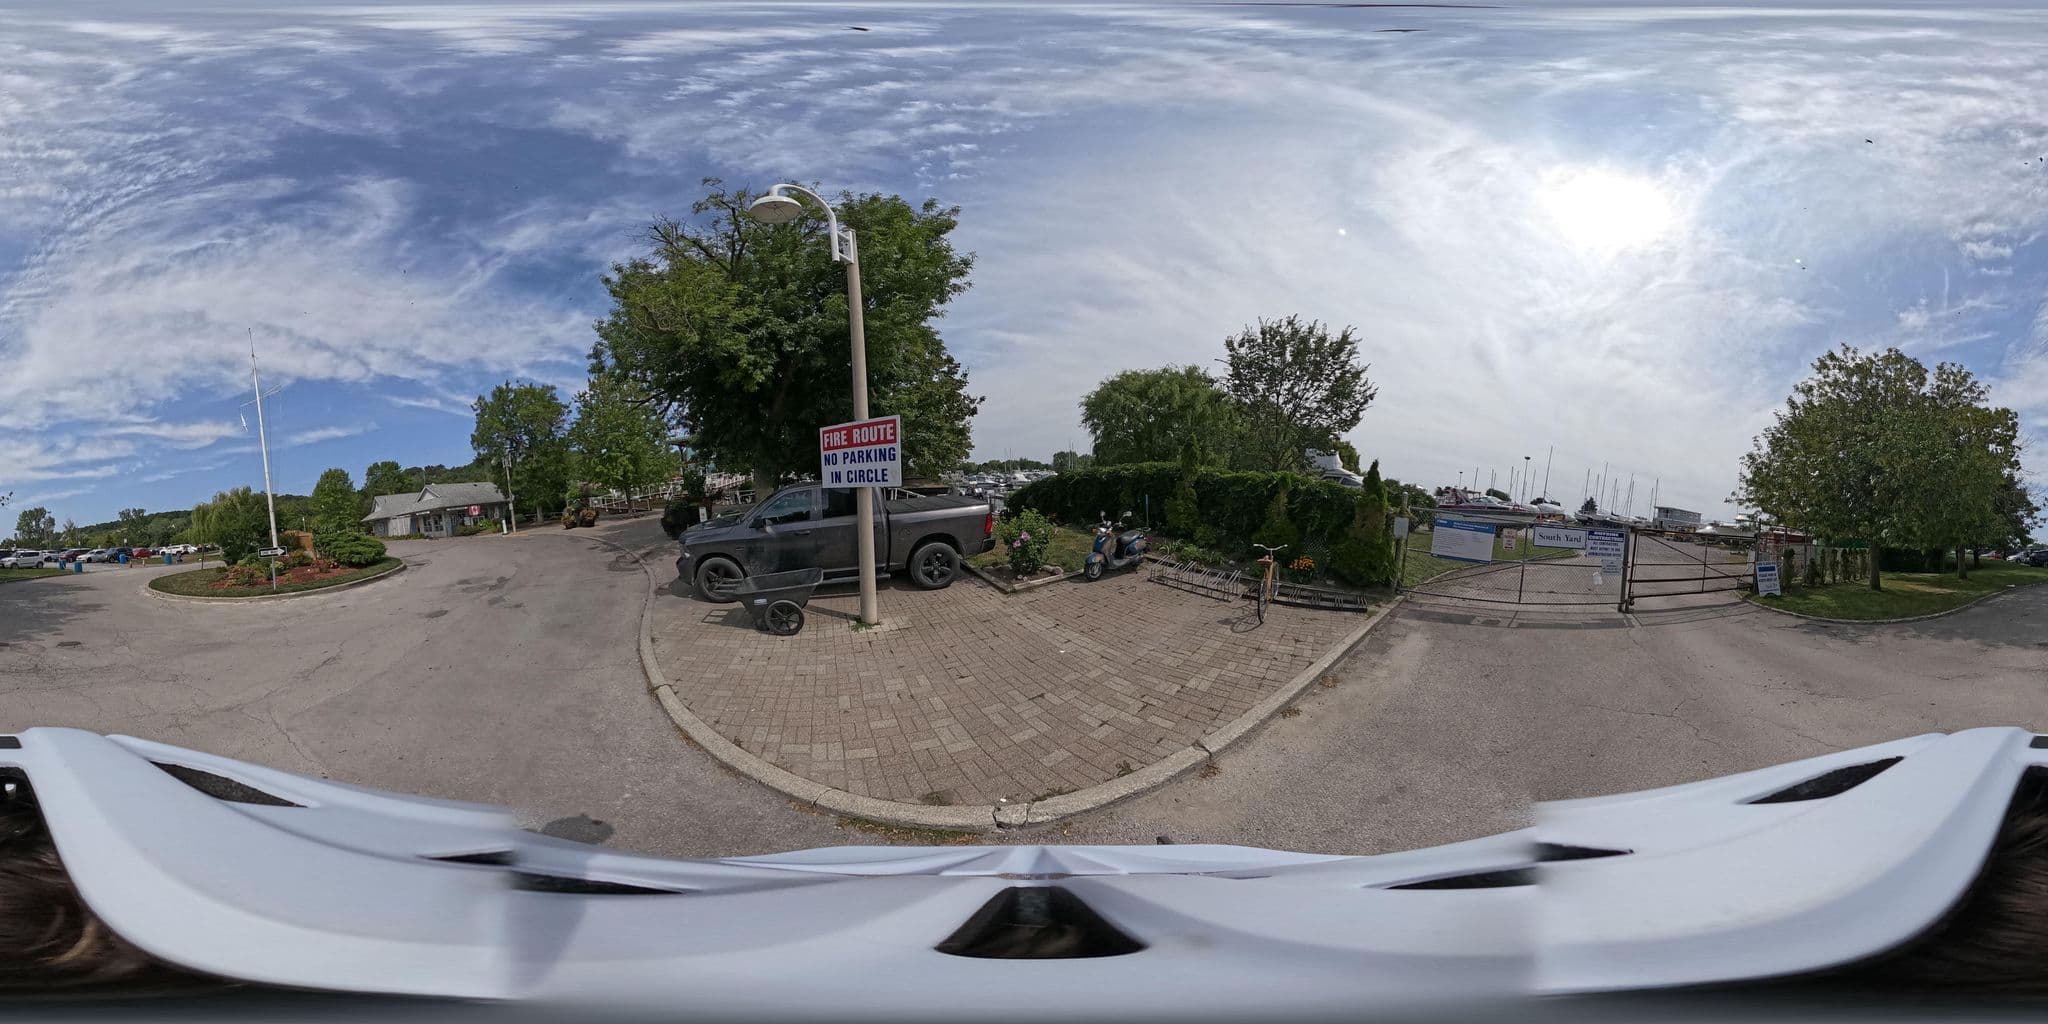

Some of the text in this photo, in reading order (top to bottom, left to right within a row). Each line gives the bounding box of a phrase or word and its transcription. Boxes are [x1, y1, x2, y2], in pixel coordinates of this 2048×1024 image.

[823, 423, 894, 448] FIRE ROUTE
[824, 447, 896, 466] NO PARKING
[831, 468, 888, 484] IN CIRCLE
[1538, 532, 1582, 542] South Yard
